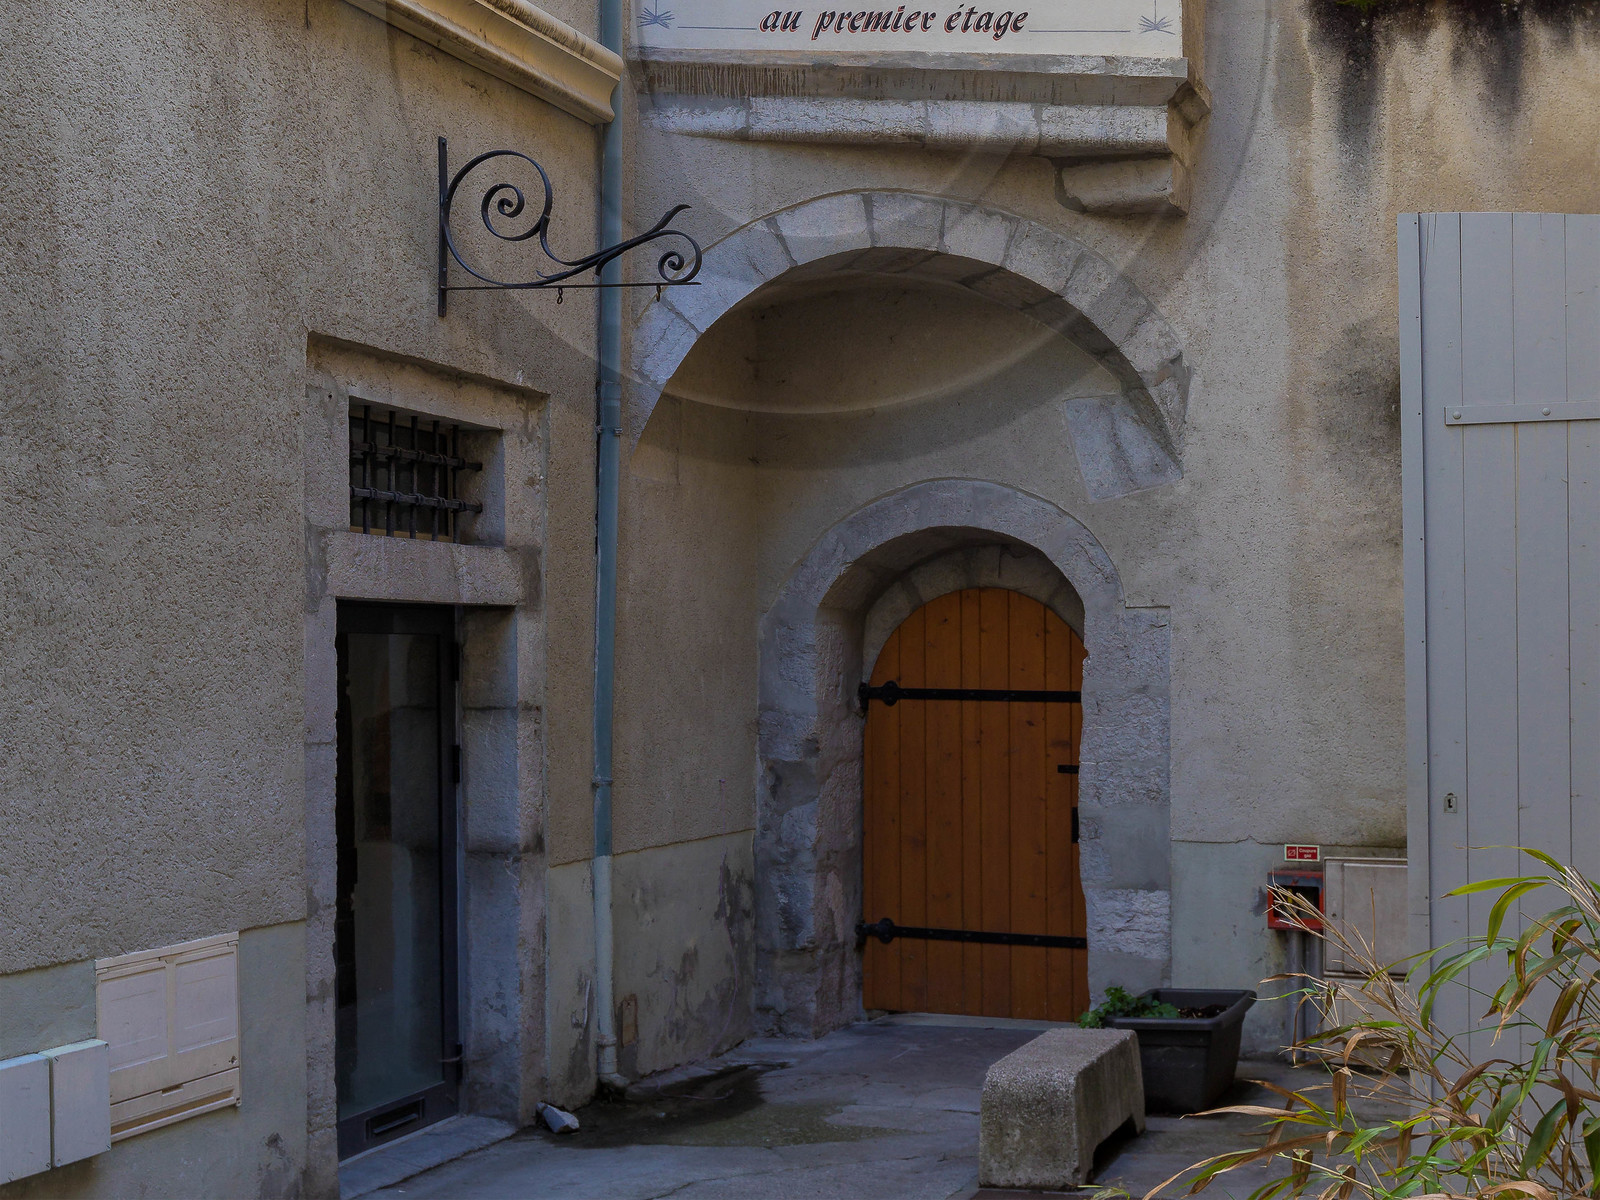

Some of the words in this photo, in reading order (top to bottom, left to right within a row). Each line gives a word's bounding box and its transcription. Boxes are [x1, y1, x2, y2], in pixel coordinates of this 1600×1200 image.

[758, 8, 803, 33] au
[810, 5, 936, 41] premier
[943, 3, 1030, 41] étage
